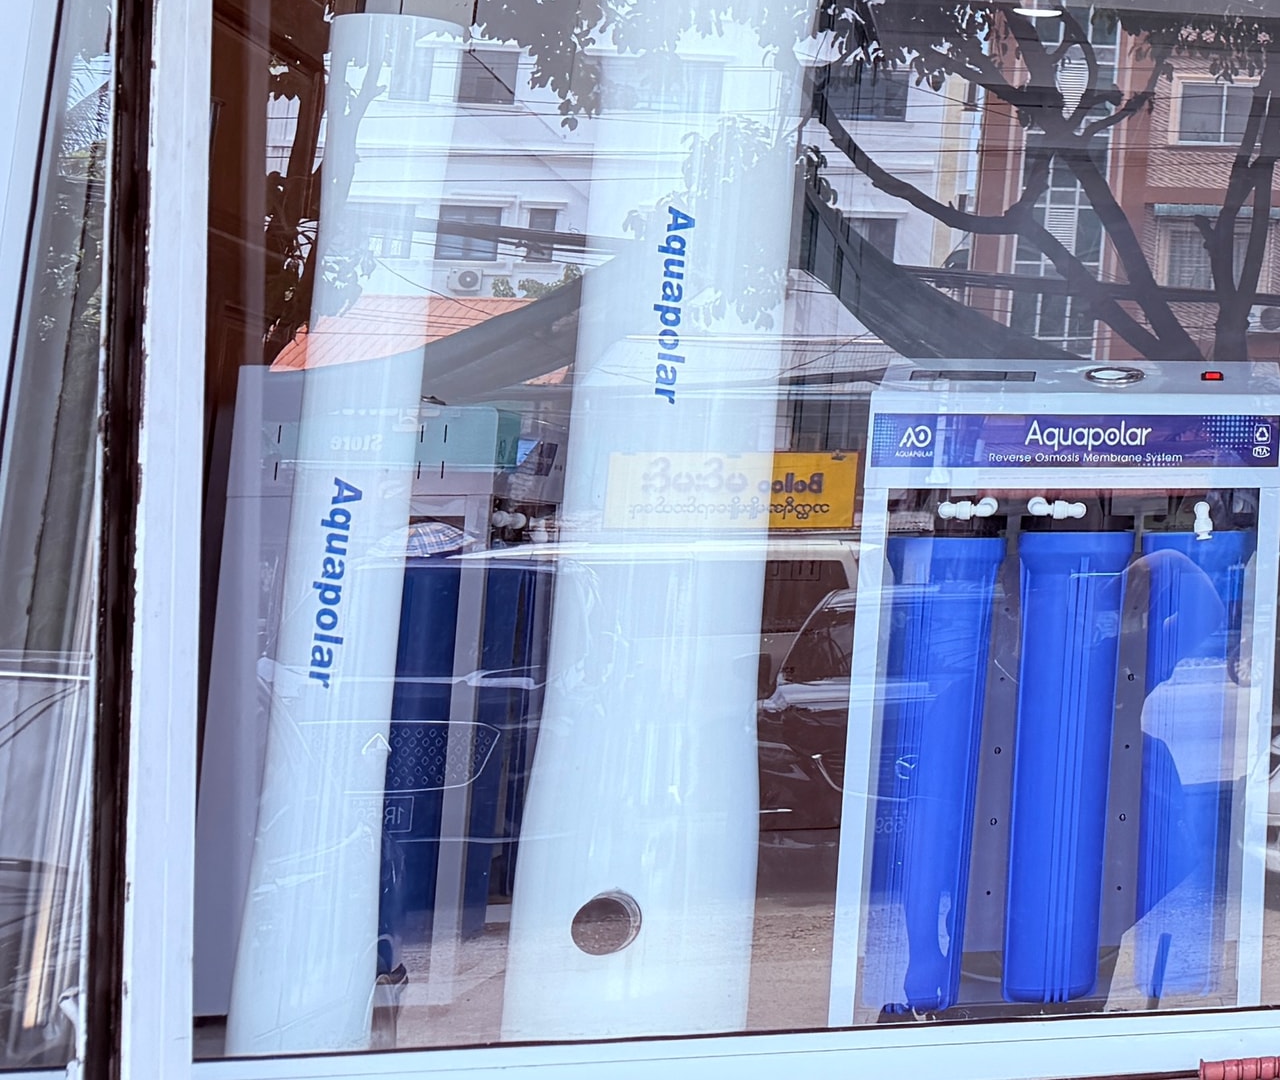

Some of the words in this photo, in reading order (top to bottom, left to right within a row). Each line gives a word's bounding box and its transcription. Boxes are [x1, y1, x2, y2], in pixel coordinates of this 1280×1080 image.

[654, 205, 696, 405] Aquapolar
[988, 452, 1032, 463] Reverse
[1034, 452, 1080, 463] Osmosis
[1083, 452, 1143, 463] Membrane
[1145, 452, 1183, 465] System
[1024, 419, 1152, 452] Aquapolar
[309, 476, 363, 689] Aquapolar
